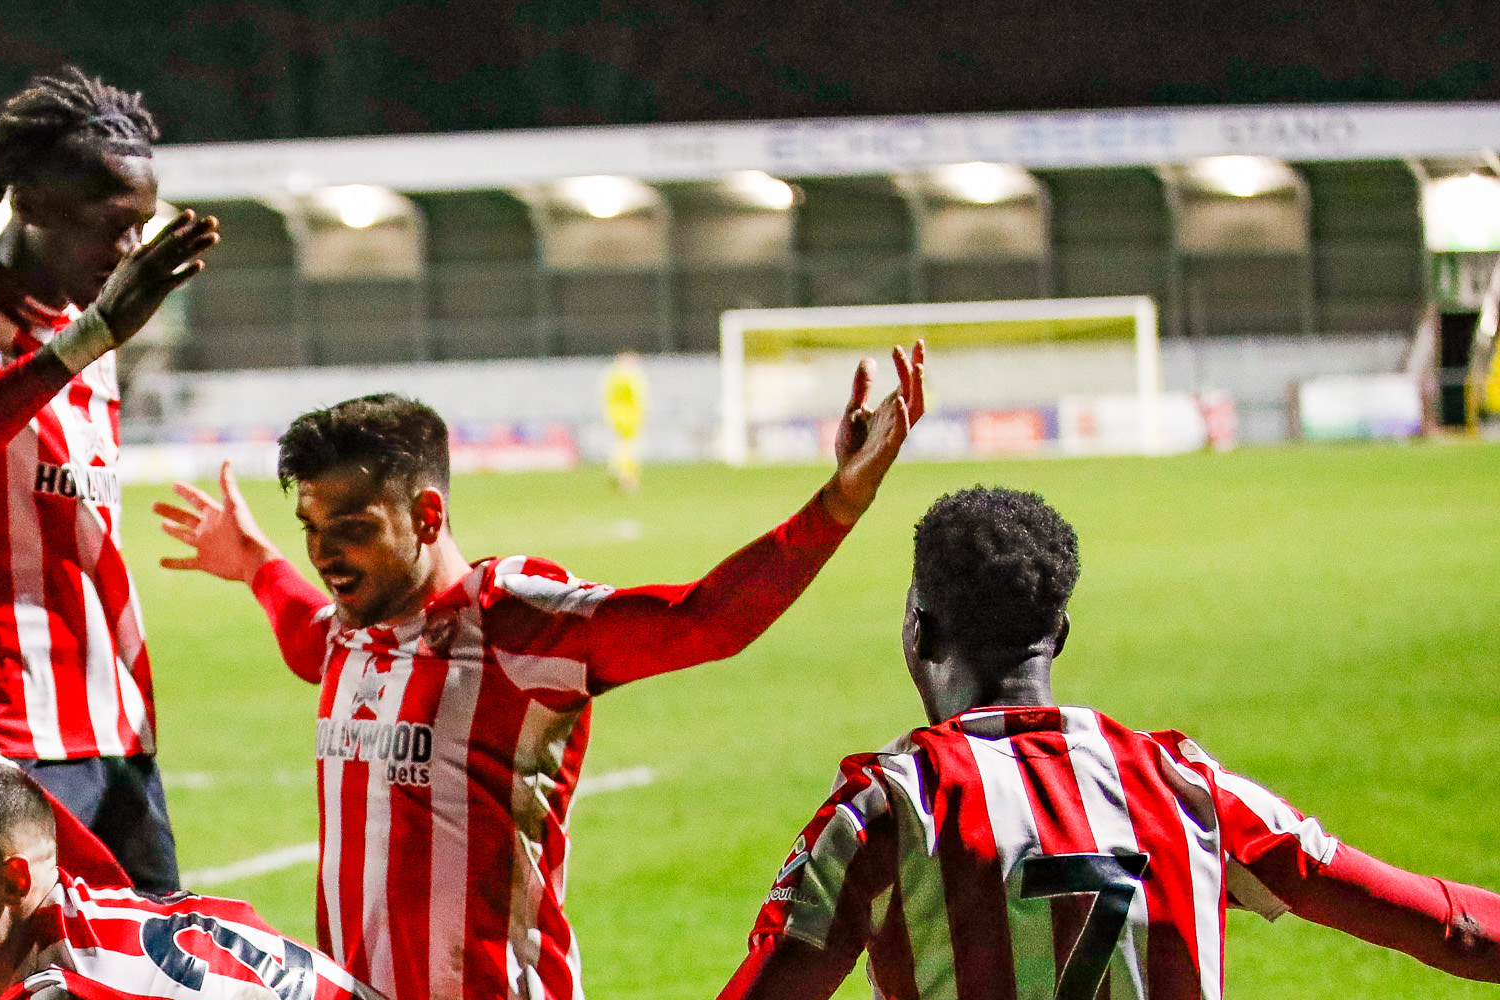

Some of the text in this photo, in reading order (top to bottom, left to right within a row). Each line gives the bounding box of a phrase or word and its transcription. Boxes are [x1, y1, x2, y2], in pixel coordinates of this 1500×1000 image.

[1219, 113, 1357, 153] STAND
[317, 721, 433, 762] OLLYWOOD
[387, 765, 430, 784] bets
